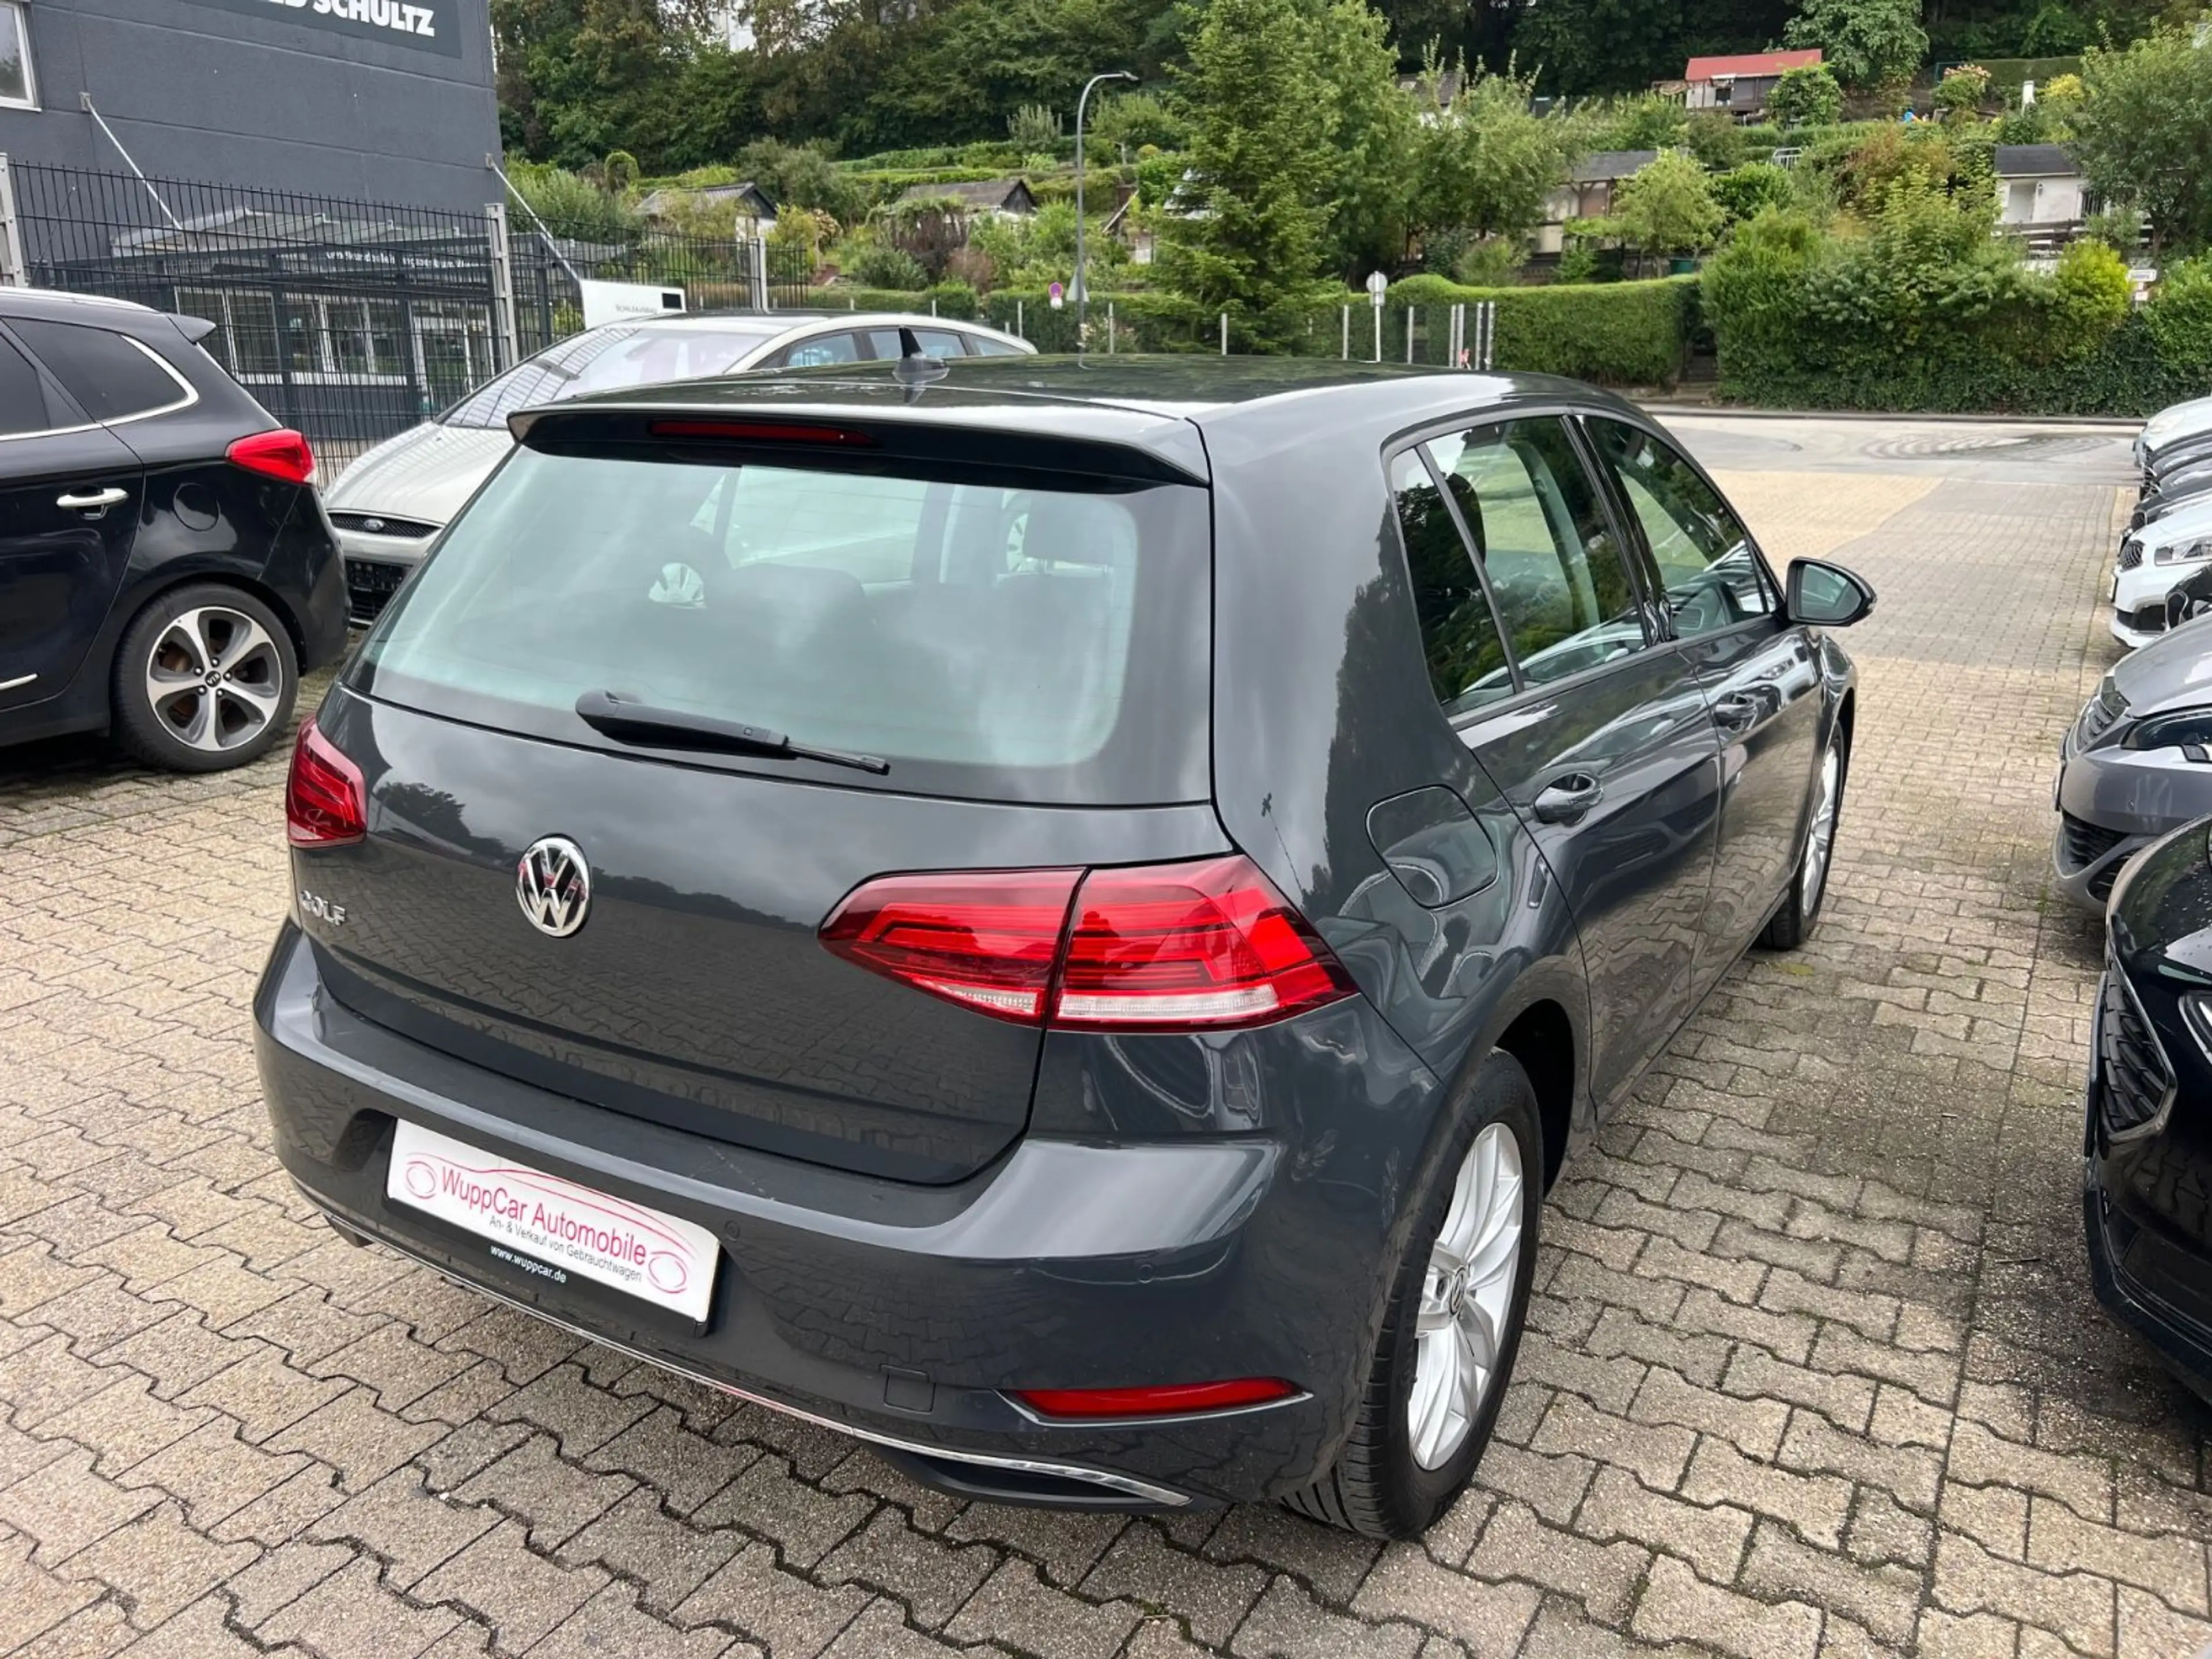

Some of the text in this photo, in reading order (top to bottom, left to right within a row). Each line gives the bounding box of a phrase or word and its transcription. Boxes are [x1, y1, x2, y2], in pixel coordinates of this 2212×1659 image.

[300, 890, 345, 926] GOLF
[442, 1166, 646, 1266] WuppCar Automobile
[491, 1245, 566, 1283] www.wuppcar.de
[506, 1221, 513, 1233] &
[516, 1224, 547, 1245] Verkauf
[549, 1238, 565, 1255] von
[567, 1244, 642, 1282] Gebrauchtwagen
